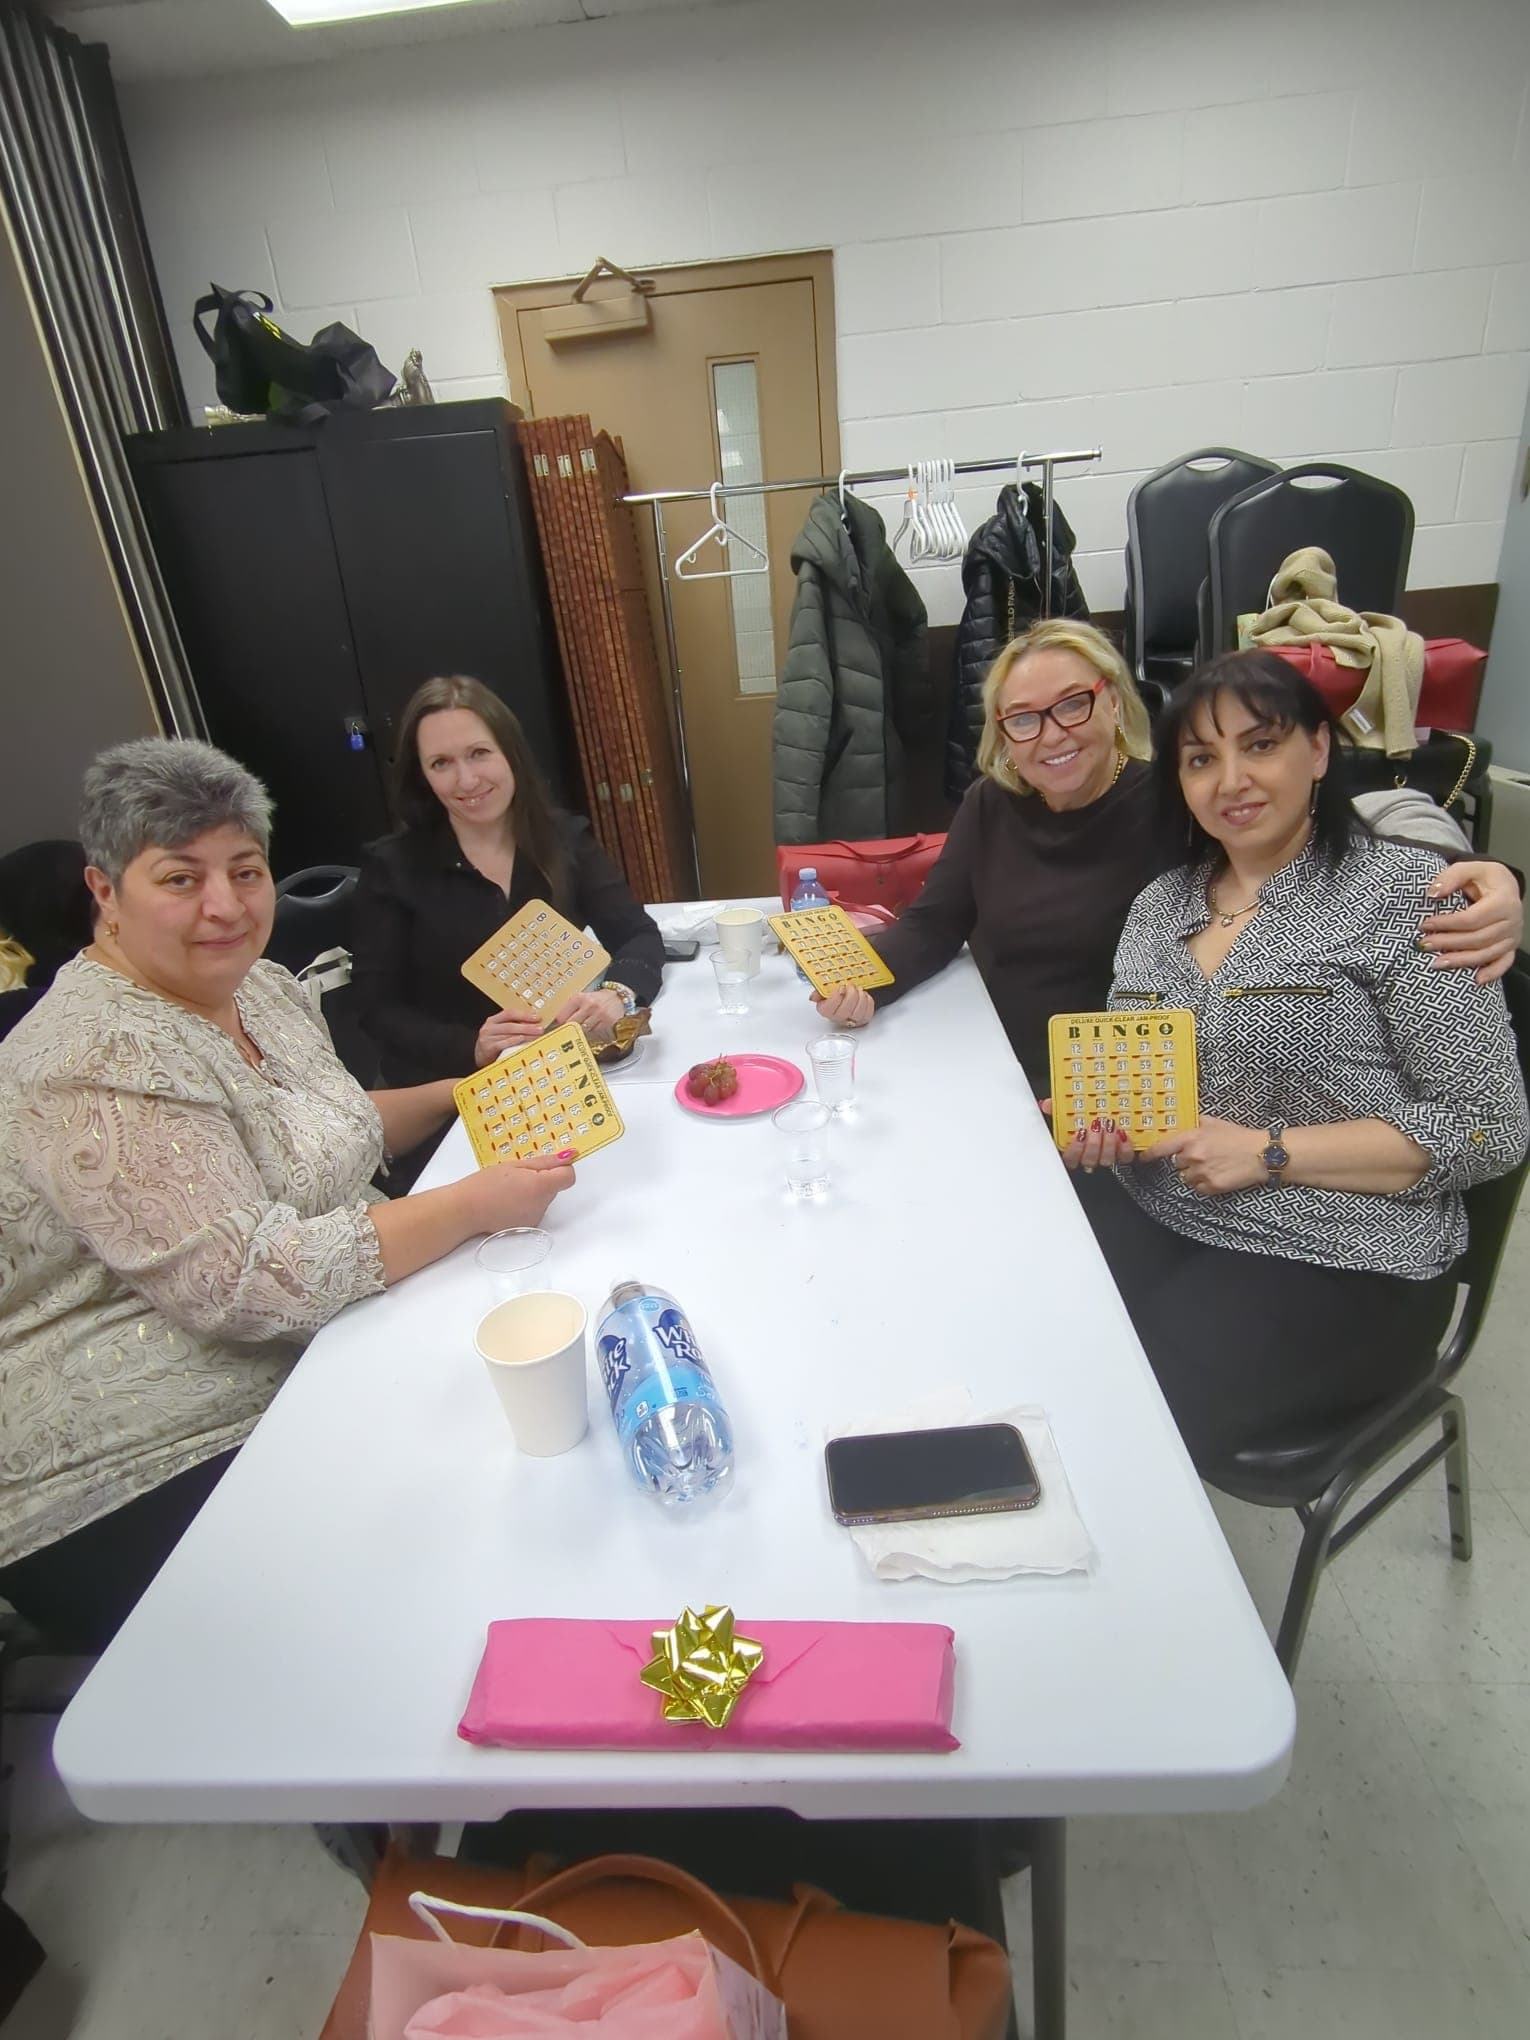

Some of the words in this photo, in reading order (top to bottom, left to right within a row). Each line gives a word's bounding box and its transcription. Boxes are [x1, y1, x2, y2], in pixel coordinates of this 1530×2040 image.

[536, 912, 594, 959] BINGO
[782, 912, 838, 929] BINGO
[1068, 1022, 1174, 1039] BINGO
[561, 1040, 606, 1127] BINGO
